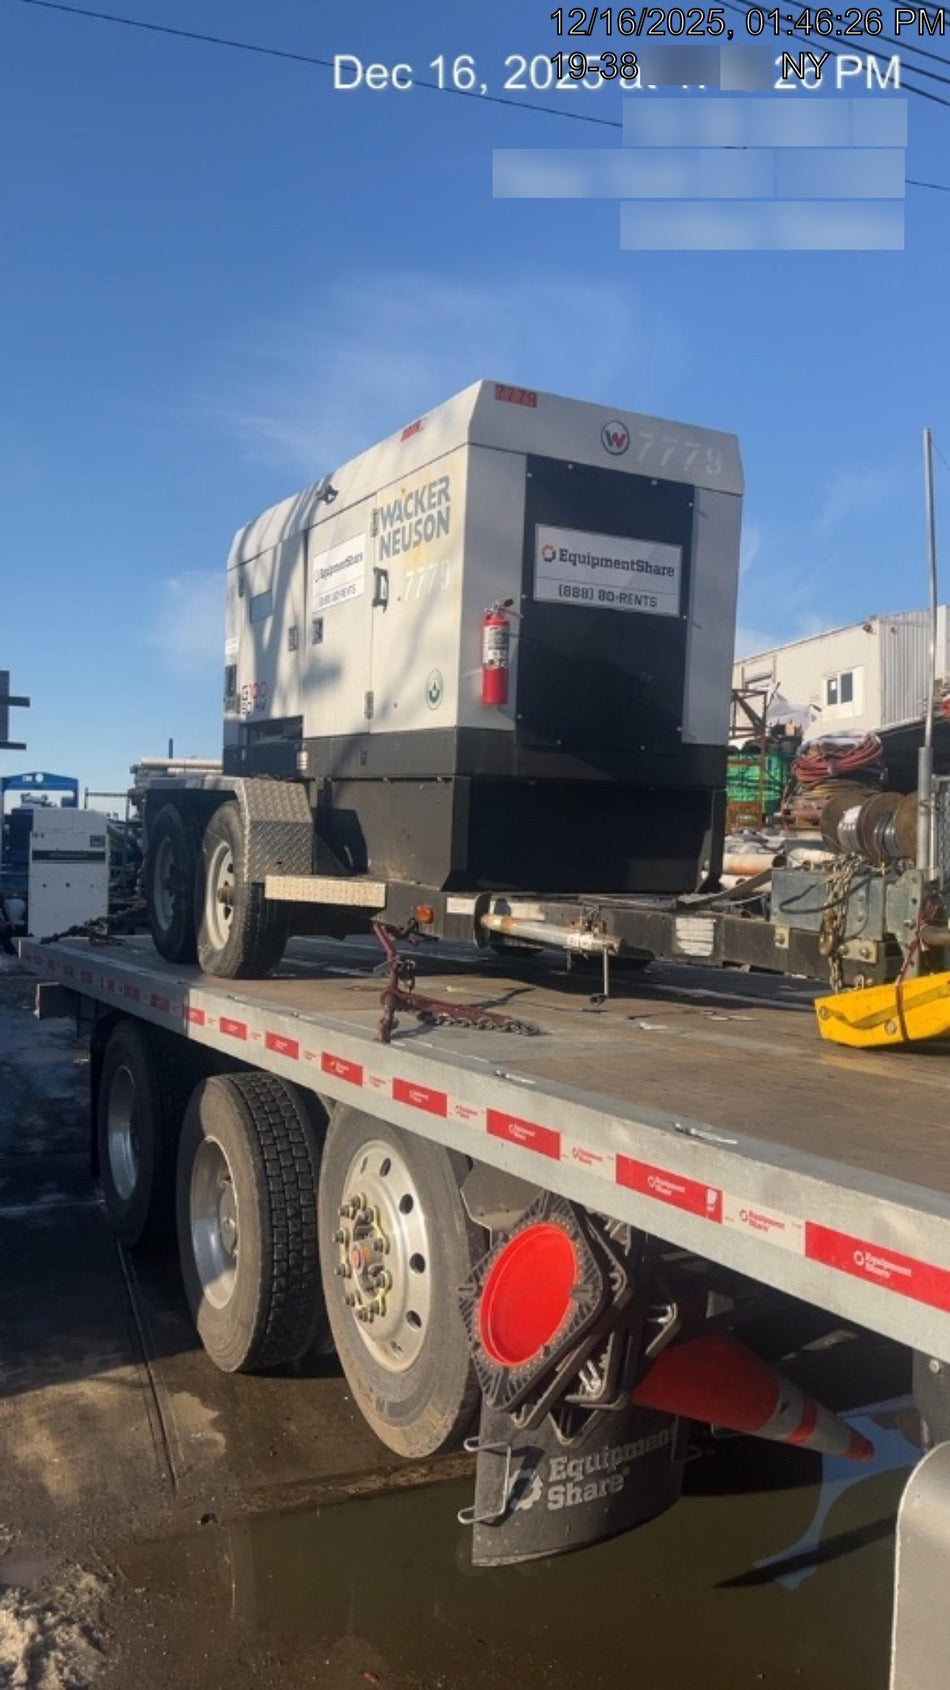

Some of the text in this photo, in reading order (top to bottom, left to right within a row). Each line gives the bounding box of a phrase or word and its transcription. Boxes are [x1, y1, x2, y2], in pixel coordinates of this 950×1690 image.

[638, 430, 722, 476] 7779
[379, 475, 451, 532] WACKER
[379, 506, 451, 562] NEUSON
[558, 548, 675, 577] EquipmentShare
[558, 583, 594, 601] (888)
